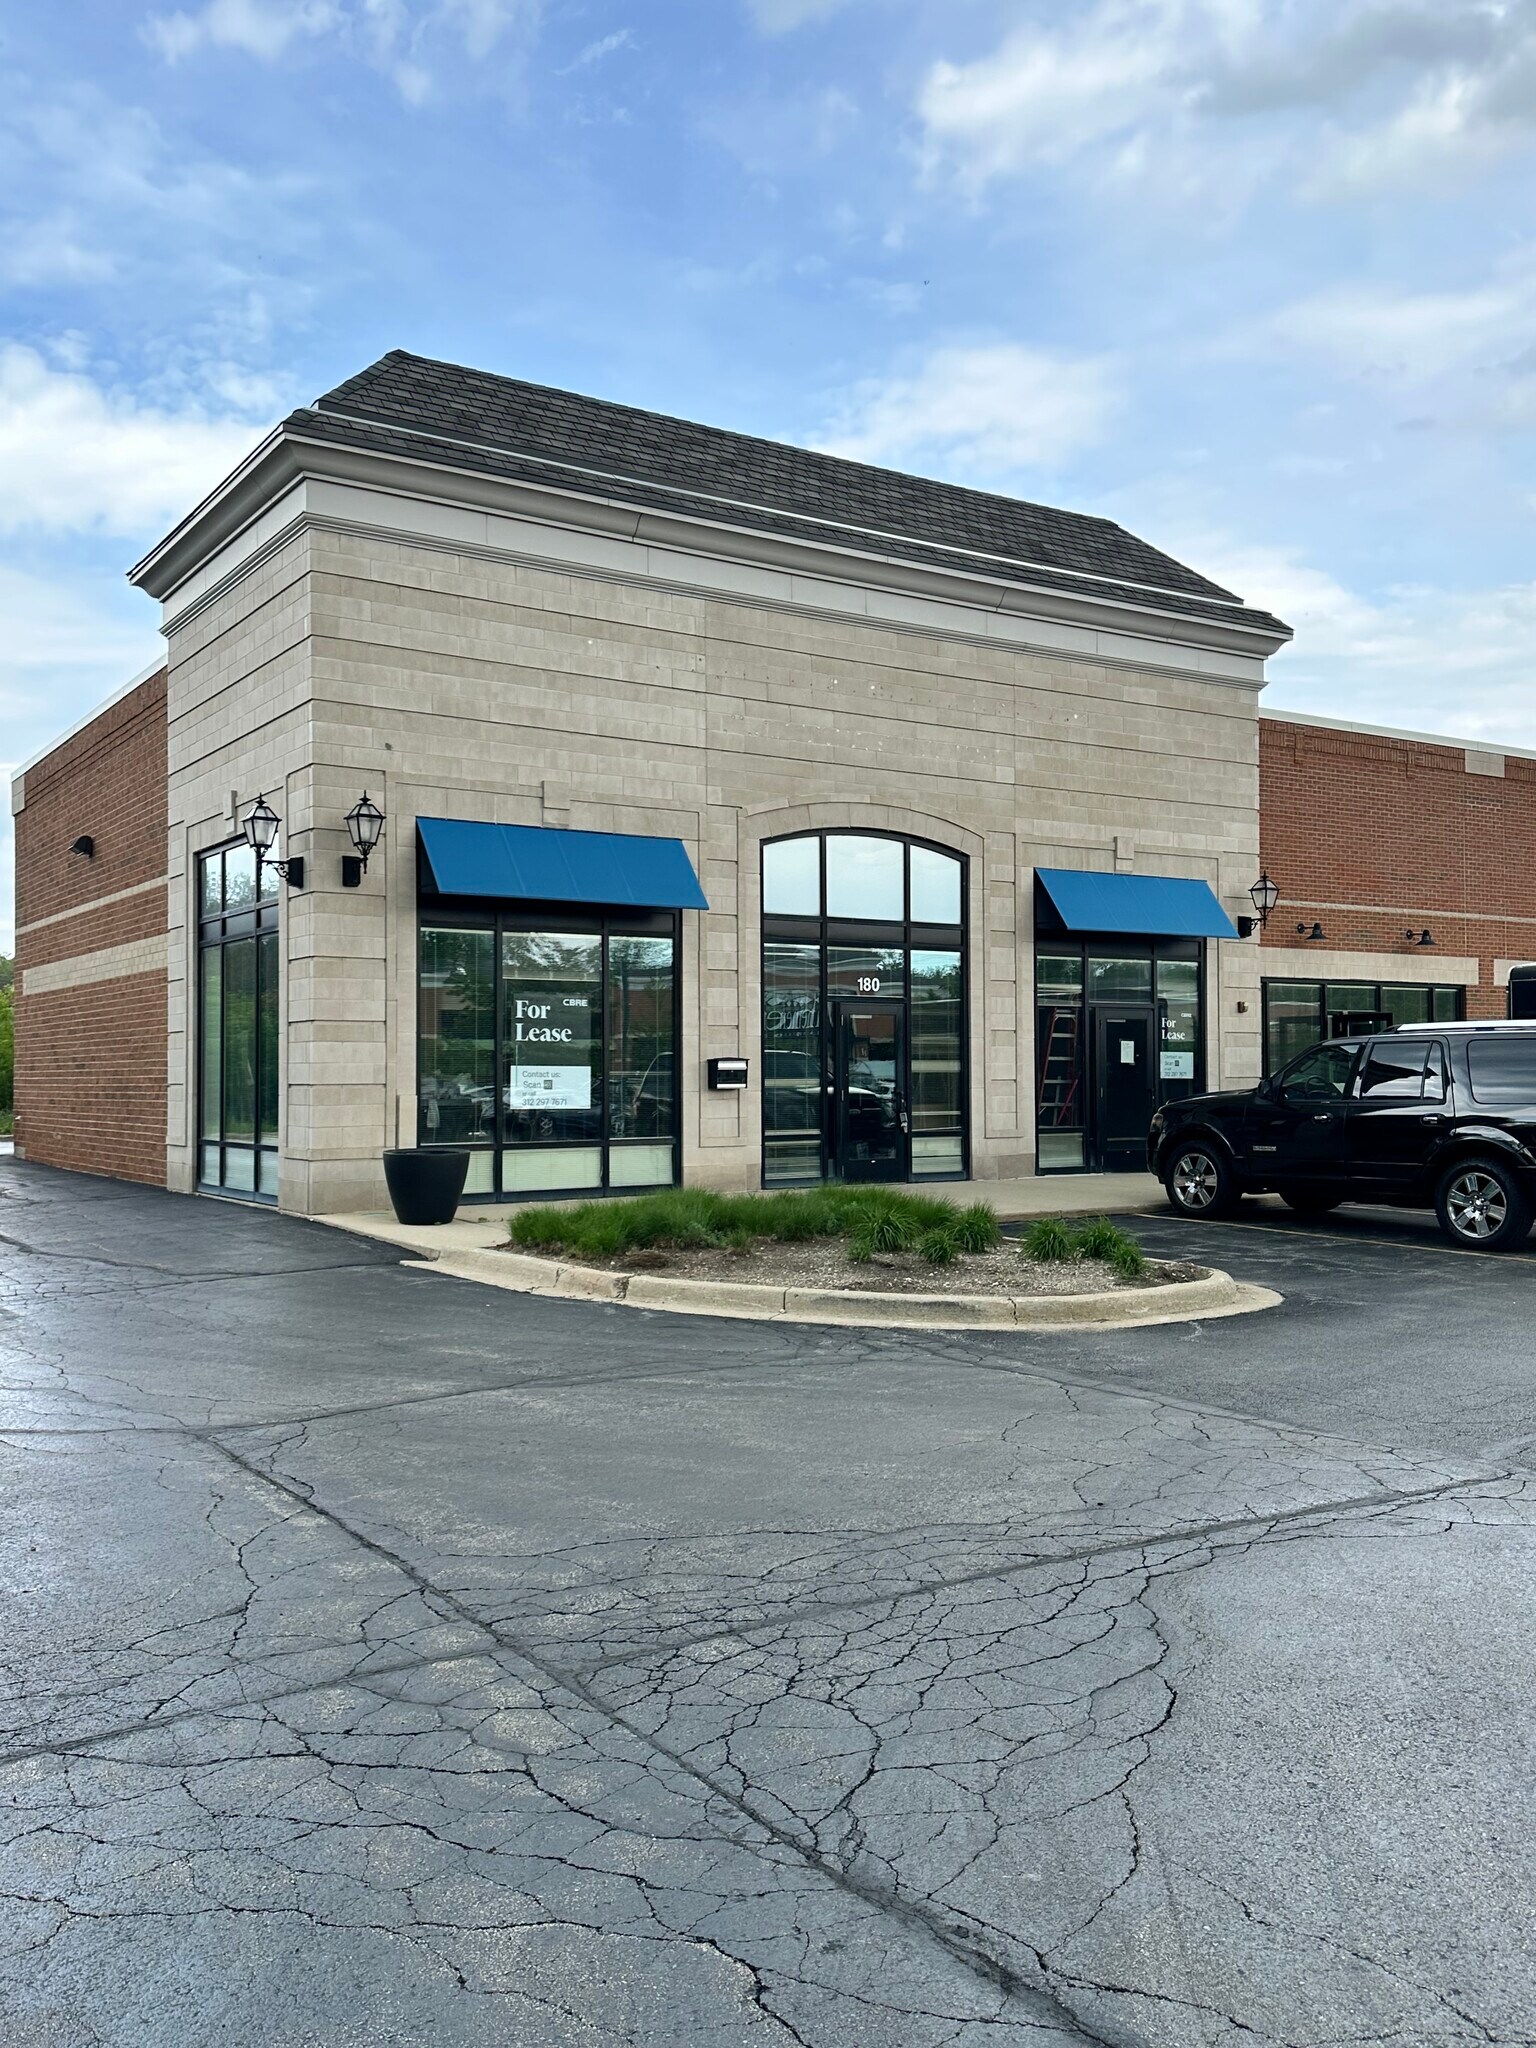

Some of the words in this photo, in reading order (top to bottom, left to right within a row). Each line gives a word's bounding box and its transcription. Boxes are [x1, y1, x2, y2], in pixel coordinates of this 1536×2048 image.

[857, 977, 880, 992] 180
[562, 999, 588, 1007] CBRE
[515, 1000, 551, 1019] For
[1161, 1017, 1176, 1027] For
[515, 1023, 572, 1042] Lease
[1161, 1029, 1185, 1040] Lease
[522, 1098, 534, 1106] 312
[536, 1098, 550, 1106] 297
